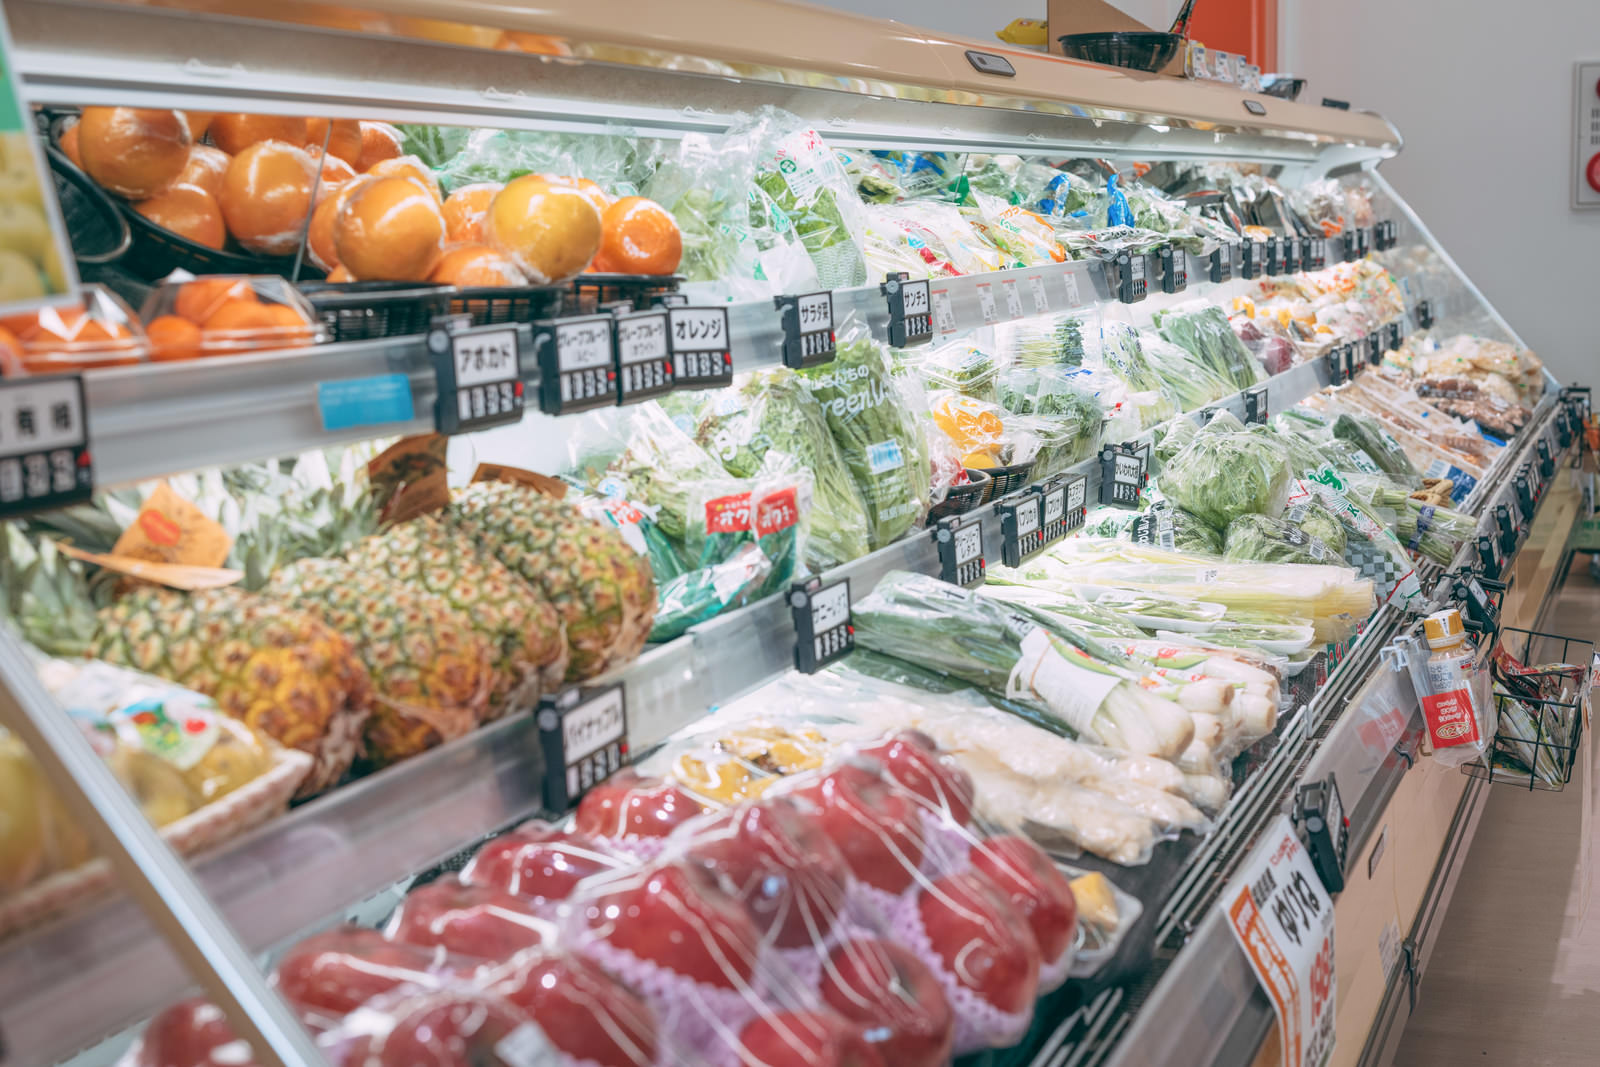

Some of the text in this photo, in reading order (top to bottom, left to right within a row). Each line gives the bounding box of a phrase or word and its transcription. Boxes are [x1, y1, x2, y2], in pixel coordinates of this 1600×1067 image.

[904, 290, 928, 308] サンチュ
[801, 301, 829, 325] サラダ菜
[675, 318, 722, 340] オレンジ
[460, 344, 511, 374] アボカド
[1271, 869, 1321, 948] ゆりね
